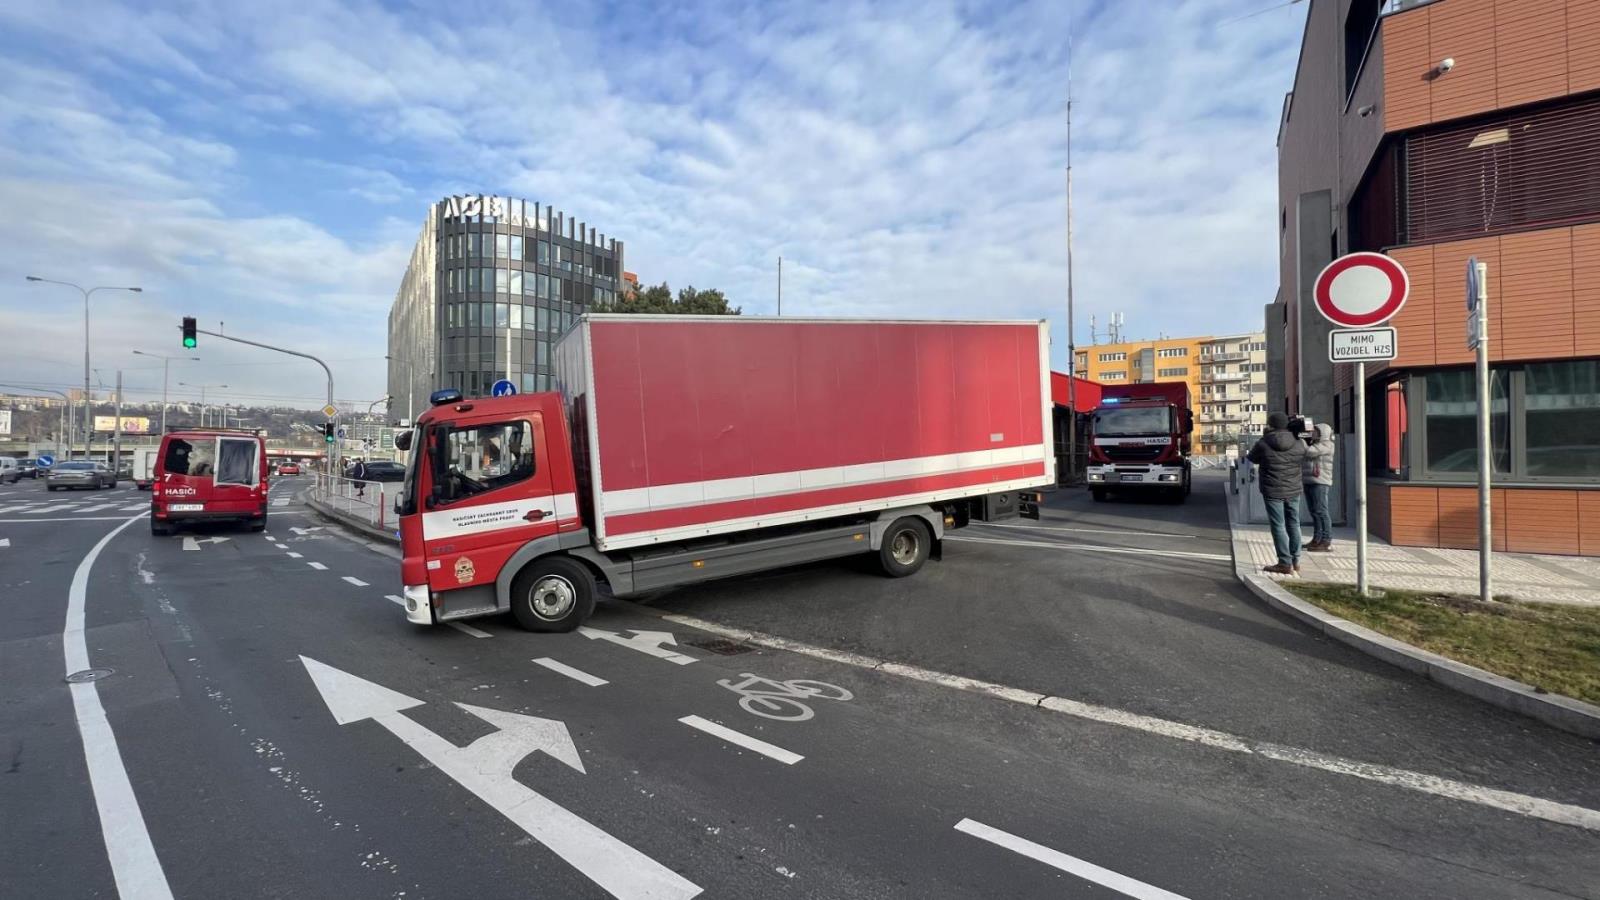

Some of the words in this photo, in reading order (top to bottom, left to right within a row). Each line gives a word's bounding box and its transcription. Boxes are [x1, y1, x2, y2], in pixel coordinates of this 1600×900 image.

[1351, 335, 1374, 344] MIMO
[1336, 346, 1370, 355] VOZIDEL
[1374, 345, 1391, 354] HZS
[164, 474, 172, 482] 7
